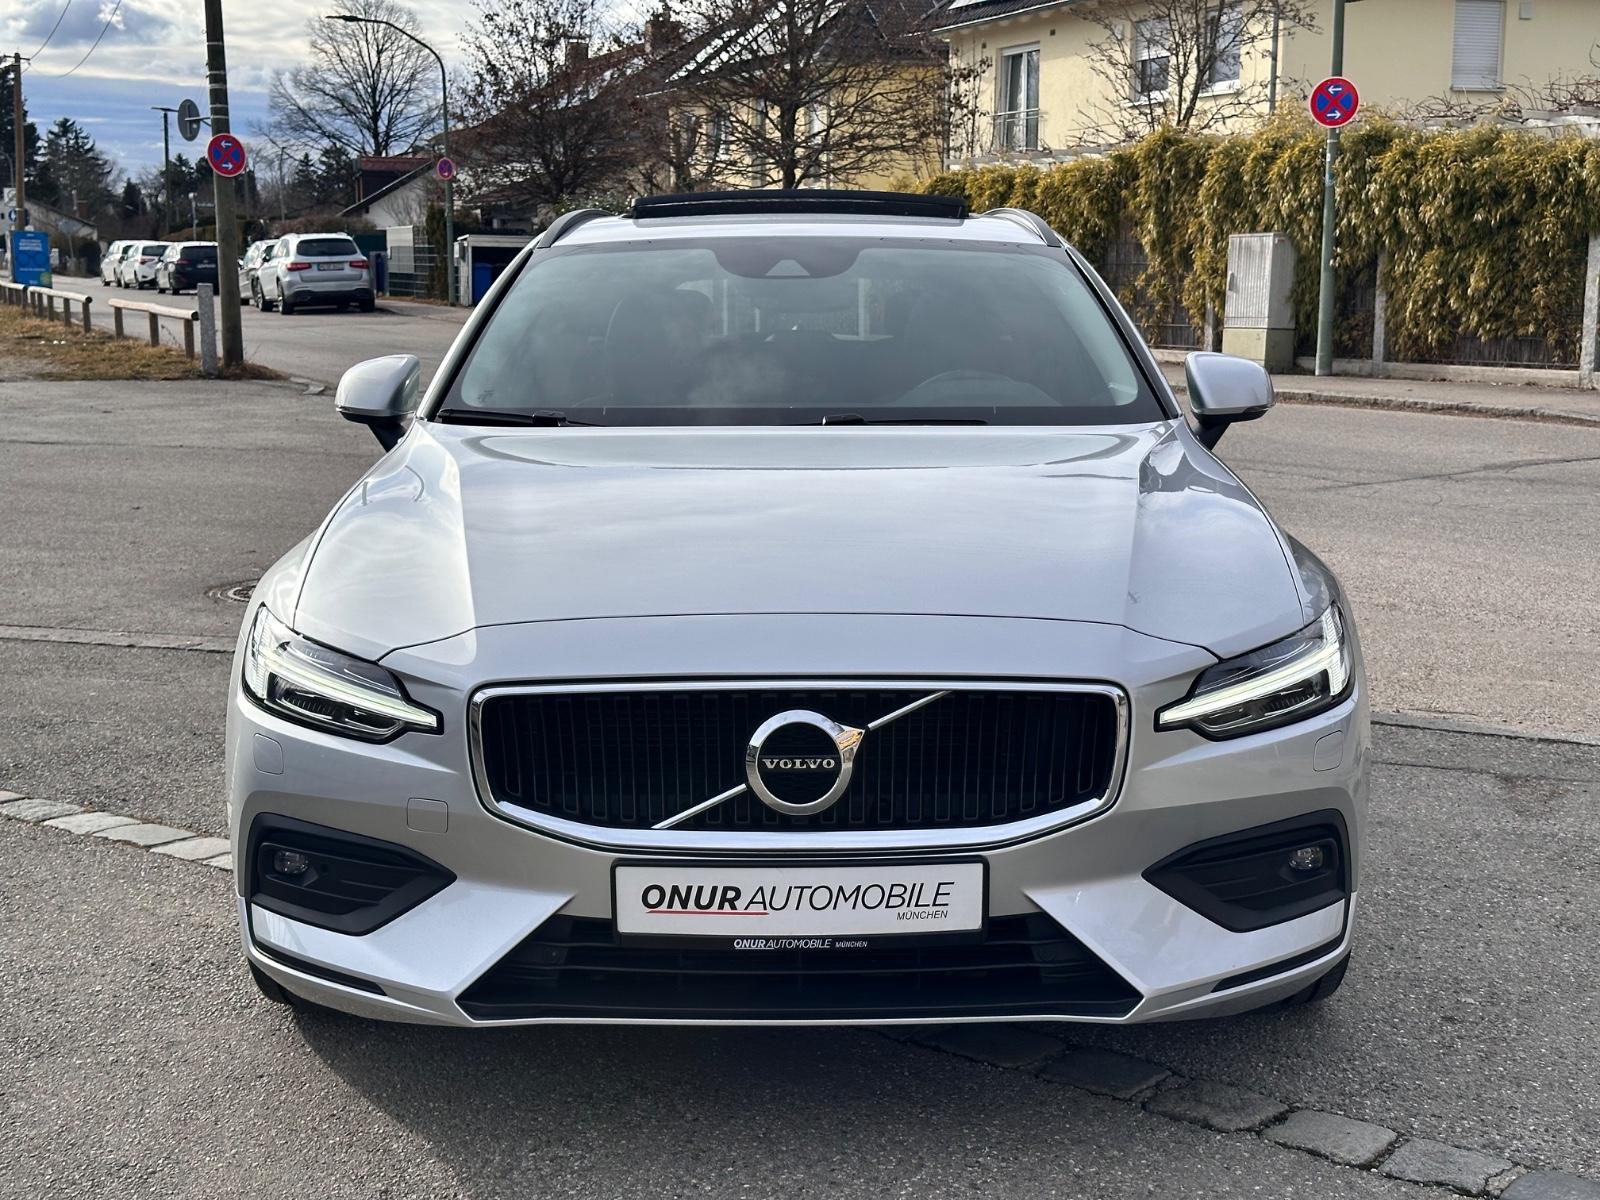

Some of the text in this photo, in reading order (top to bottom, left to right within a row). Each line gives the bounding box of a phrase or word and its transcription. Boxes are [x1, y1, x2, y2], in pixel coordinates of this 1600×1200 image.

[761, 758, 835, 769] VOLVO
[641, 881, 955, 911] ONUR AUTOMOBILE
[896, 909, 948, 920] MÜNCHEN
[835, 940, 868, 948] MÜNCHEN
